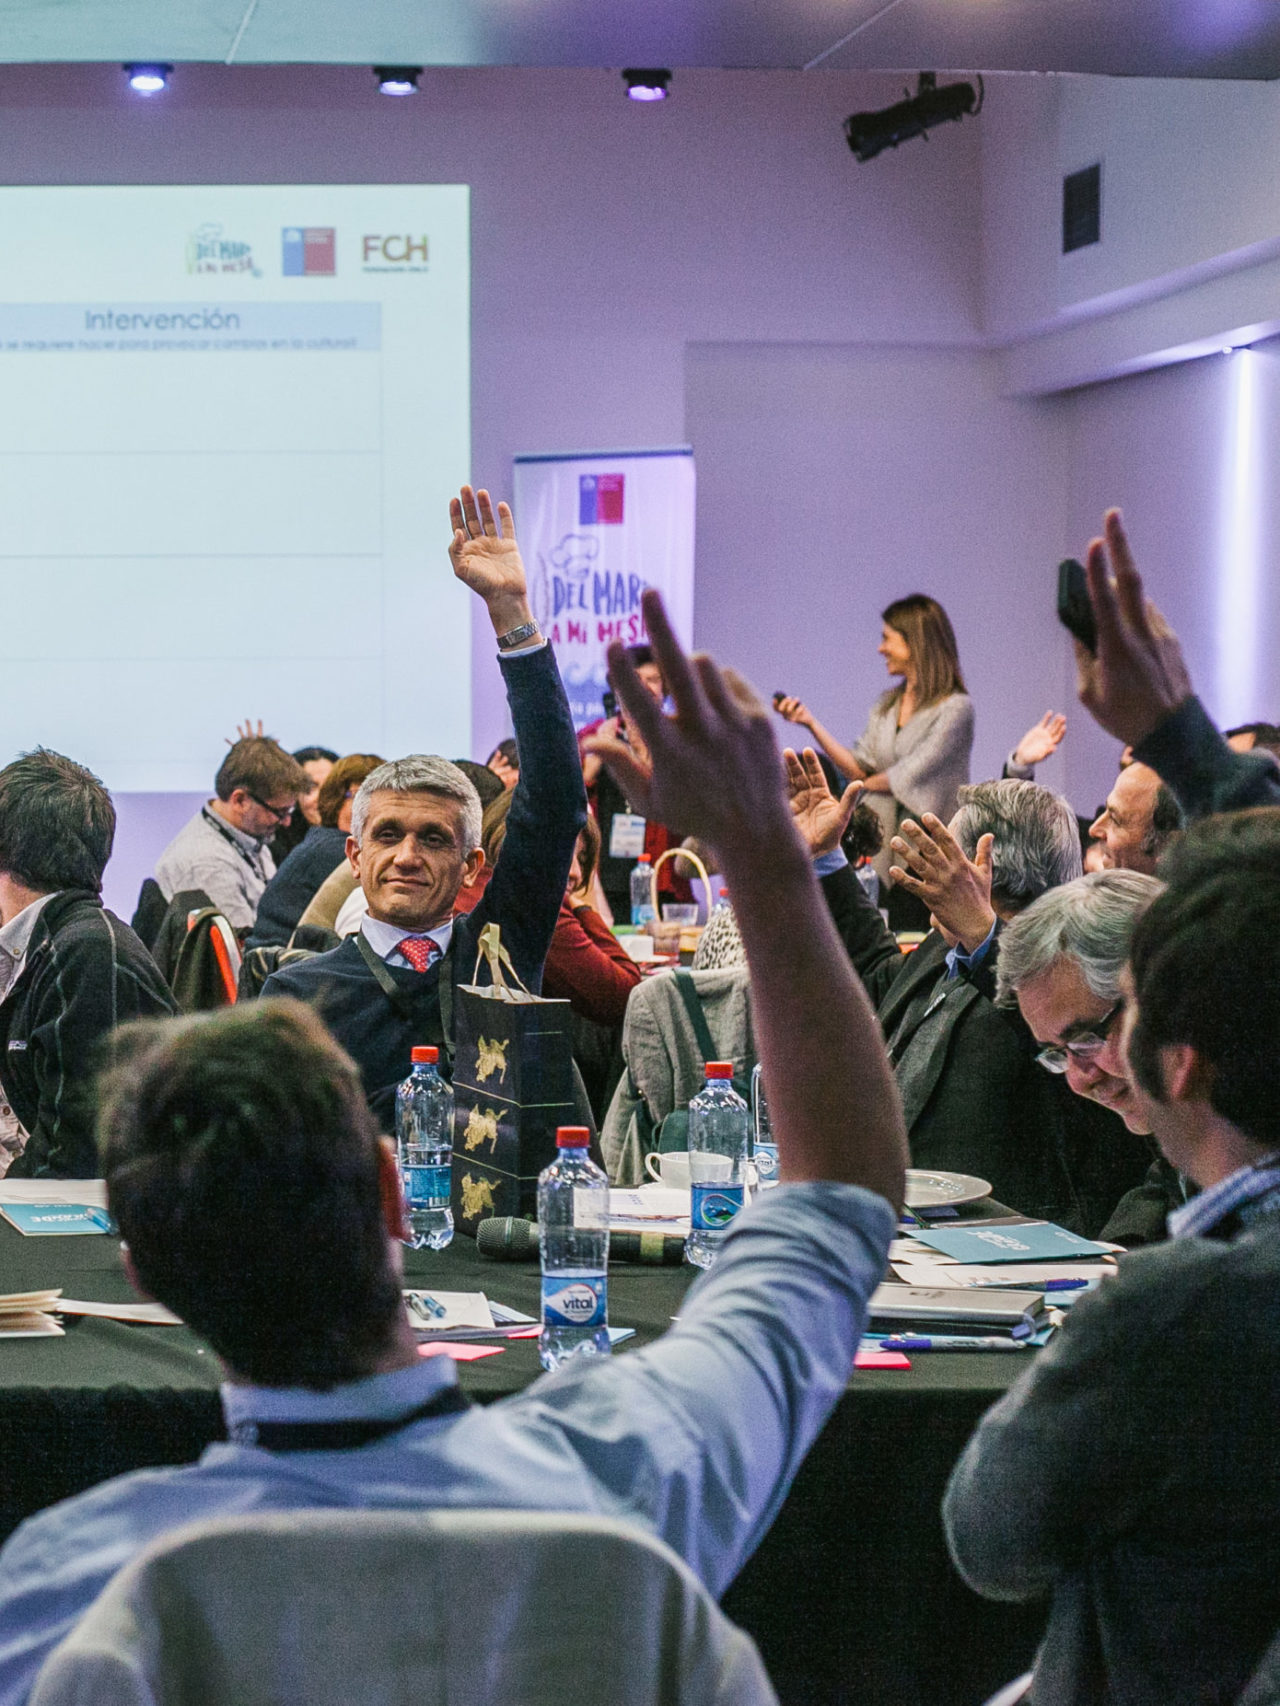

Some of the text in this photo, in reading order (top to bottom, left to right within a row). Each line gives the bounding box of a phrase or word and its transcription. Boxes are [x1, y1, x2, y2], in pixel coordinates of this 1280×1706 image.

[362, 235, 428, 261] FCH
[85, 307, 240, 331] Intervención
[552, 568, 640, 618] DEL MAR
[597, 614, 647, 644] MES
[562, 1295, 594, 1310] vital
